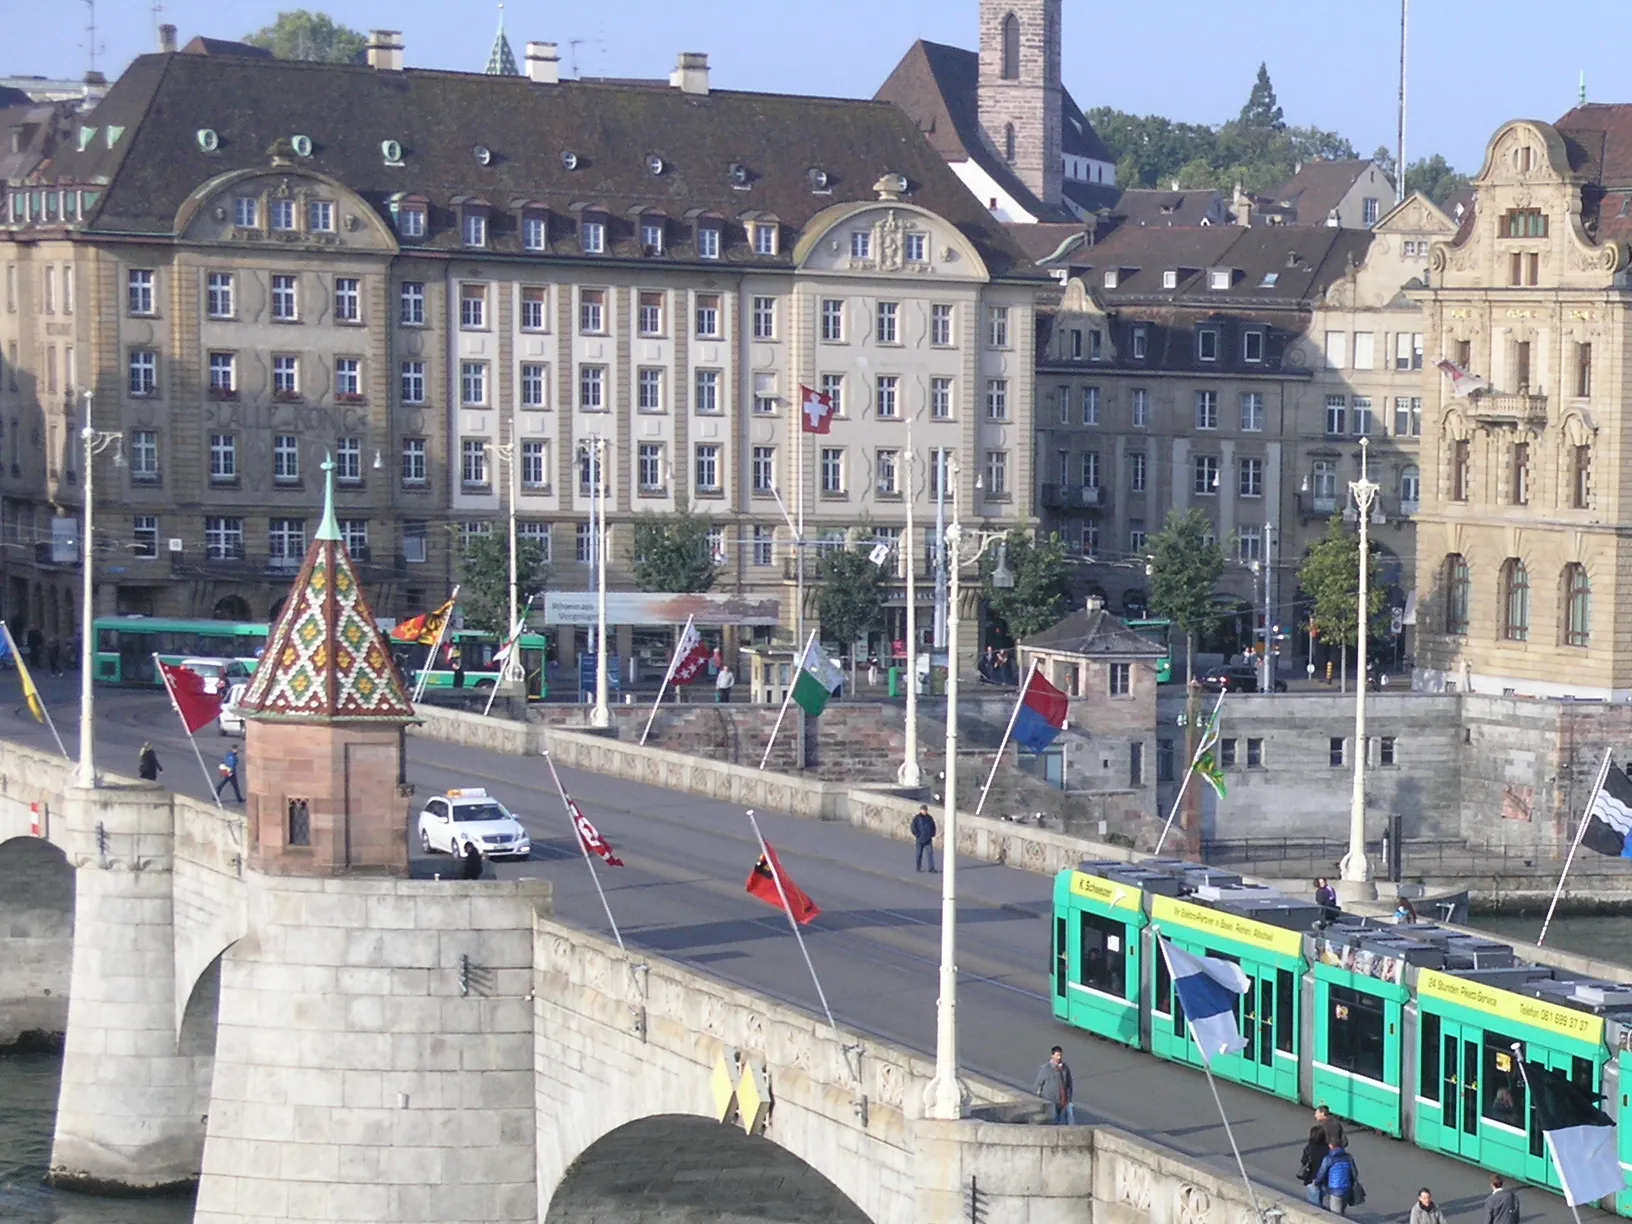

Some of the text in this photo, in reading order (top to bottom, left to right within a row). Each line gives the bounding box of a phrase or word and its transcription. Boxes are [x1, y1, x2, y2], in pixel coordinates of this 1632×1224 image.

[1427, 977, 1437, 989] 24
[1437, 979, 1460, 995] Stunden
[1519, 1003, 1540, 1019] Telefon
[1540, 1008, 1554, 1021] 061
[1568, 1016, 1580, 1029] 37
[1579, 1020, 1590, 1032] 37
